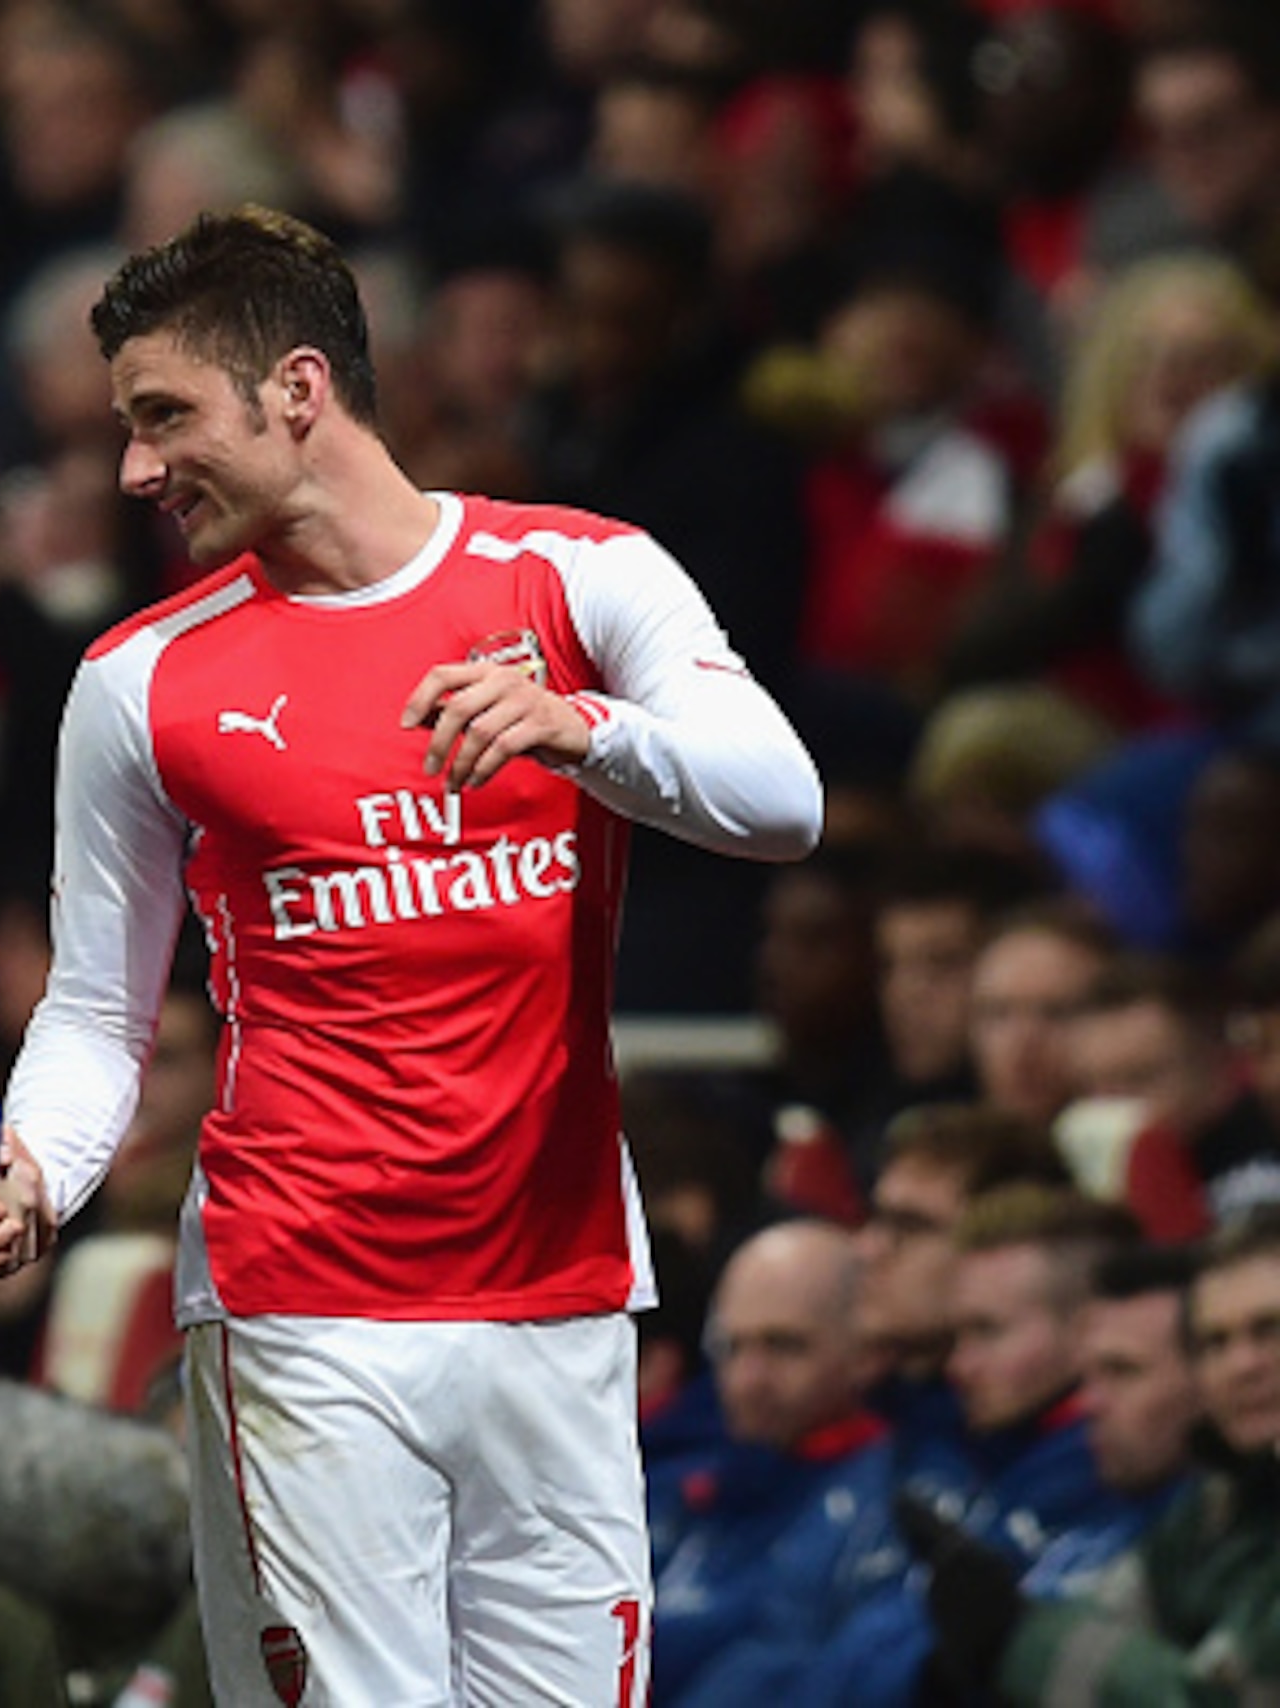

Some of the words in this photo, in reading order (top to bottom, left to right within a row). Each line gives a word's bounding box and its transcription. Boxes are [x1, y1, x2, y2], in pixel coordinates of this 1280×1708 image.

[357, 790, 461, 846] Fly
[263, 831, 580, 941] Emirates
[609, 1599, 651, 1708] 1
